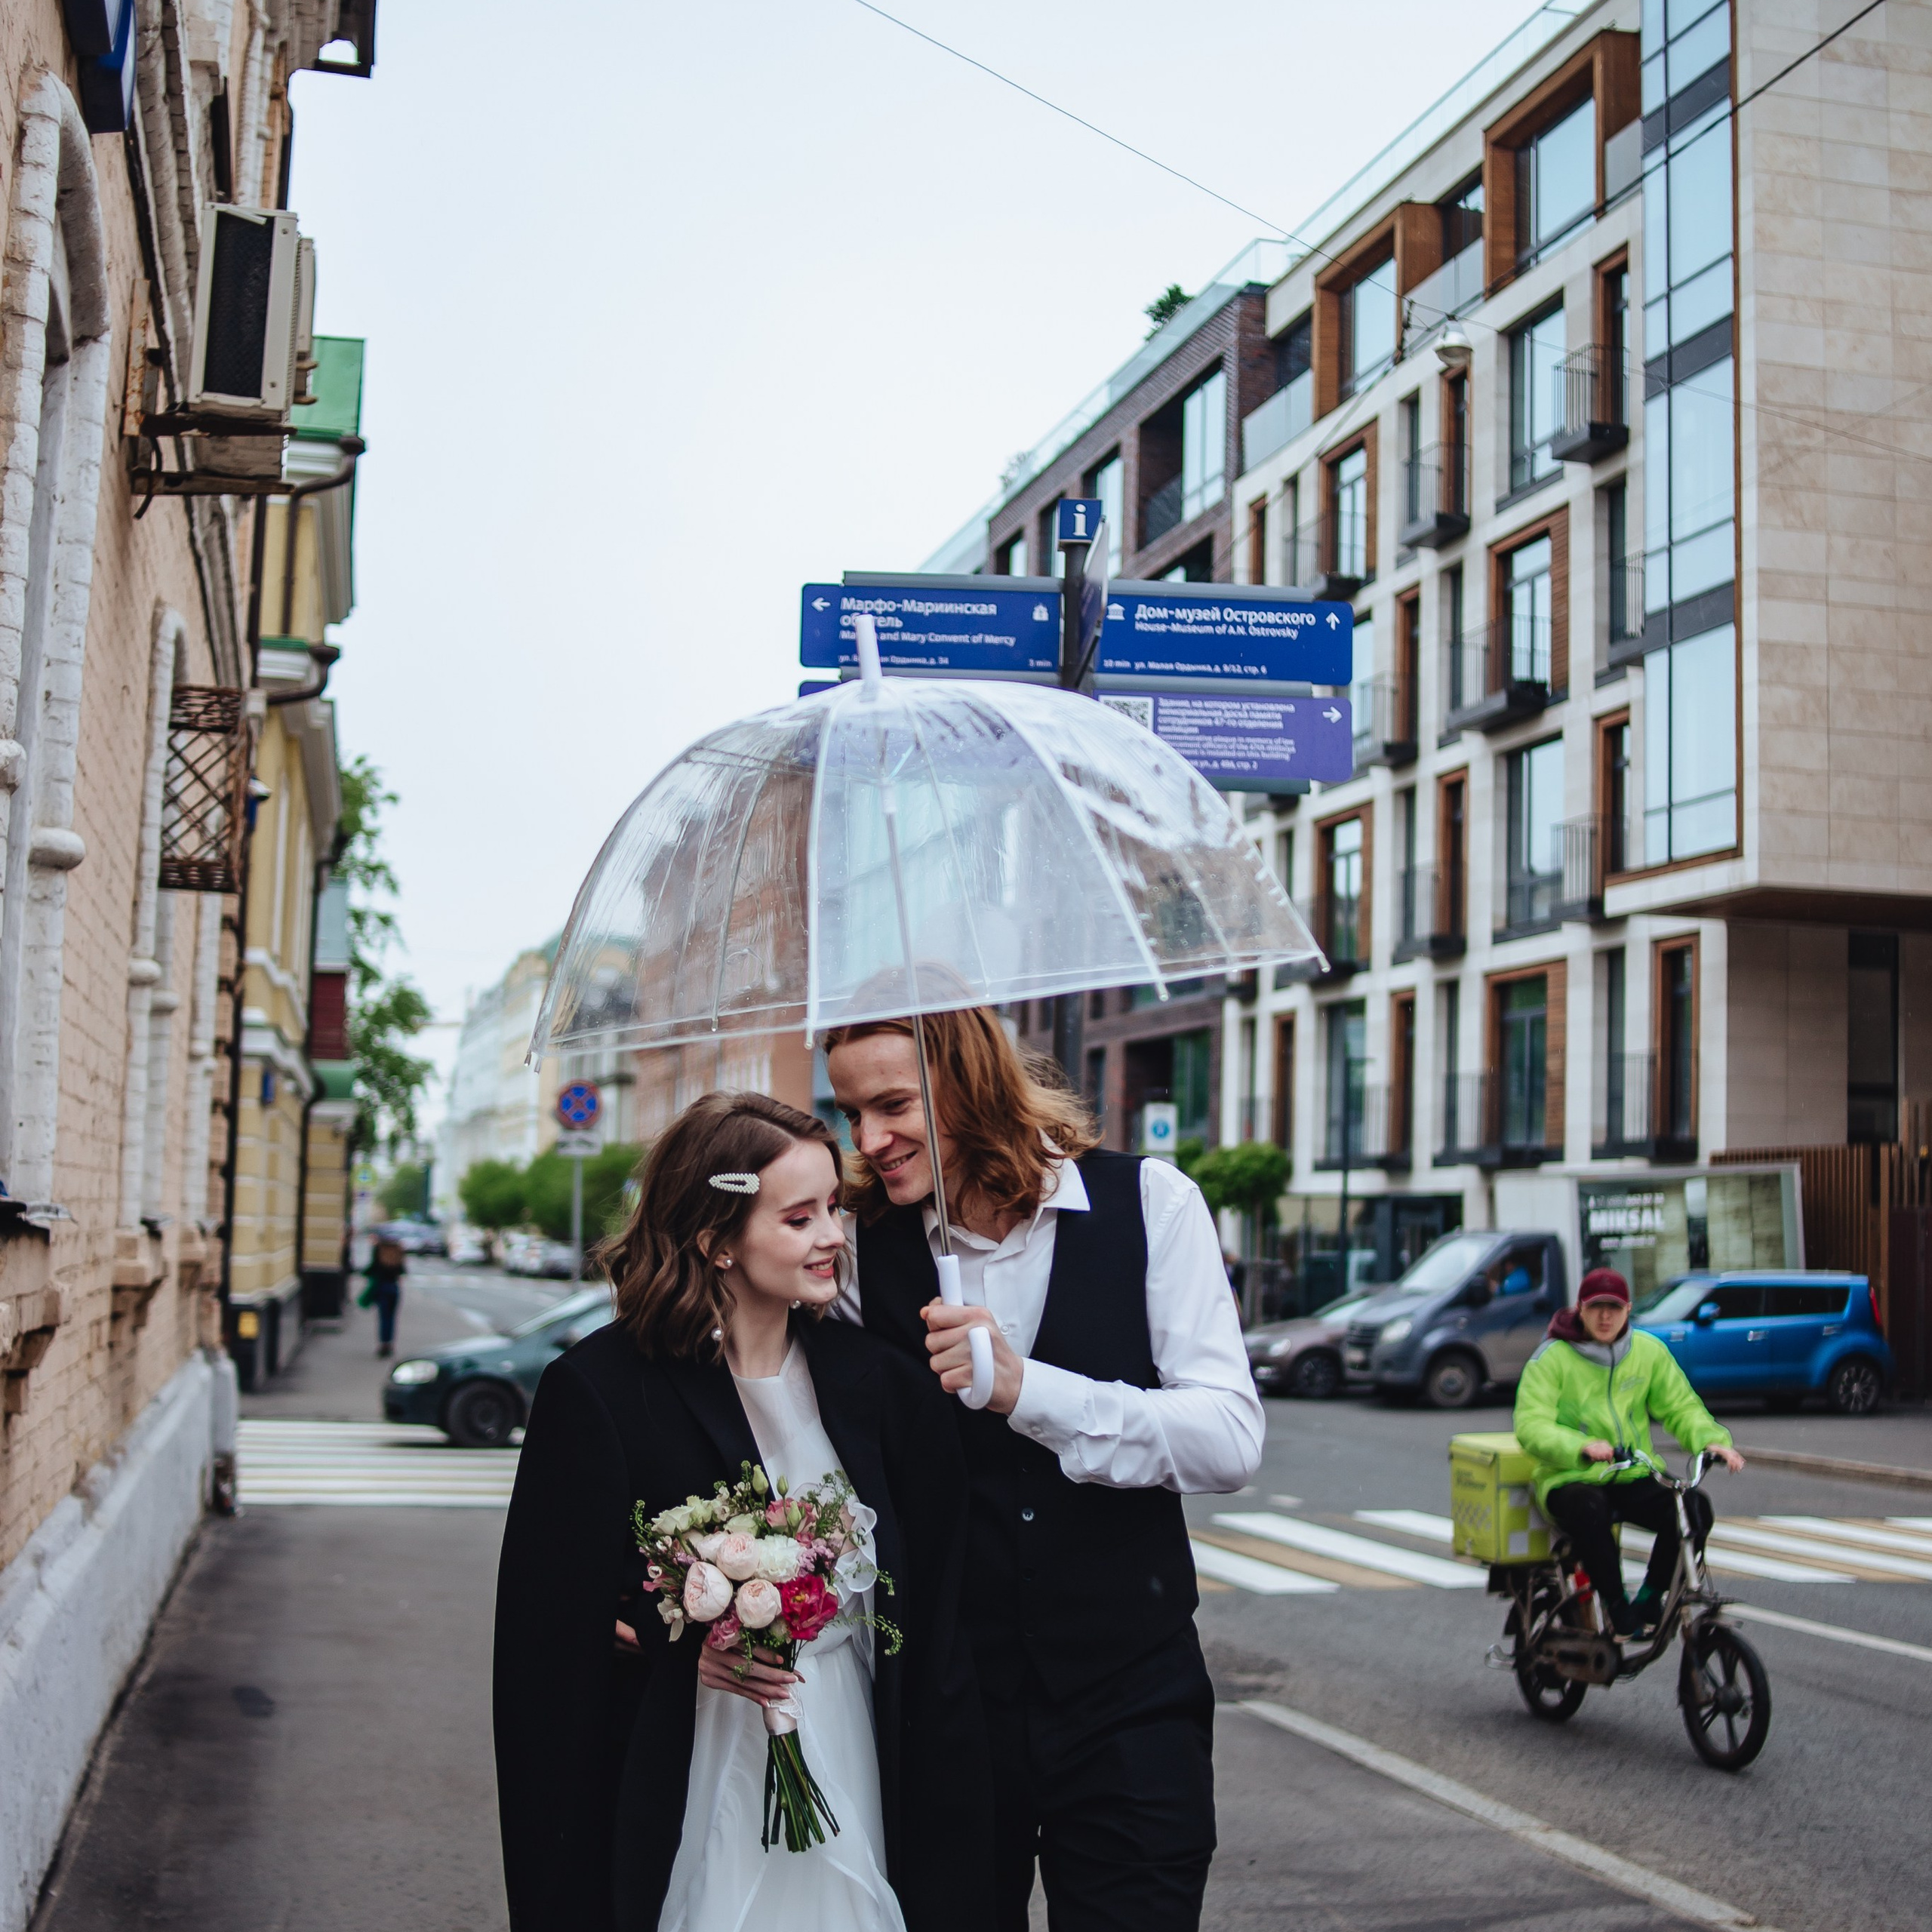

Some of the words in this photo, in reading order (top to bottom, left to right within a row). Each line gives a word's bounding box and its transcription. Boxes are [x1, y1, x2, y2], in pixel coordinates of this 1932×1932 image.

[840, 597, 997, 616] Марфо-Мариинская
[1134, 604, 1221, 623] Дом-музей
[1223, 608, 1316, 626] Островского
[1134, 621, 1214, 634] House-Museum
[1214, 623, 1227, 635] of
[1248, 625, 1298, 640] Ostrovsky
[879, 631, 900, 641] and
[900, 632, 926, 645] Mary
[928, 632, 971, 644] Convent
[971, 633, 984, 644] of
[985, 634, 1016, 648] Mercy
[1035, 659, 1052, 667] min
[1114, 660, 1131, 669] min
[1147, 661, 1174, 671] Малая
[1191, 700, 1203, 708] на
[1204, 700, 1241, 710] котором
[1241, 702, 1296, 713] установлена
[1158, 708, 1222, 718] мемориальная
[1223, 709, 1247, 719] доска
[1249, 711, 1282, 721] памяти
[1157, 715, 1212, 726] сотрудников
[1214, 717, 1237, 728] 47-го
[1238, 719, 1284, 730] отделения
[1157, 725, 1199, 734] милиции
